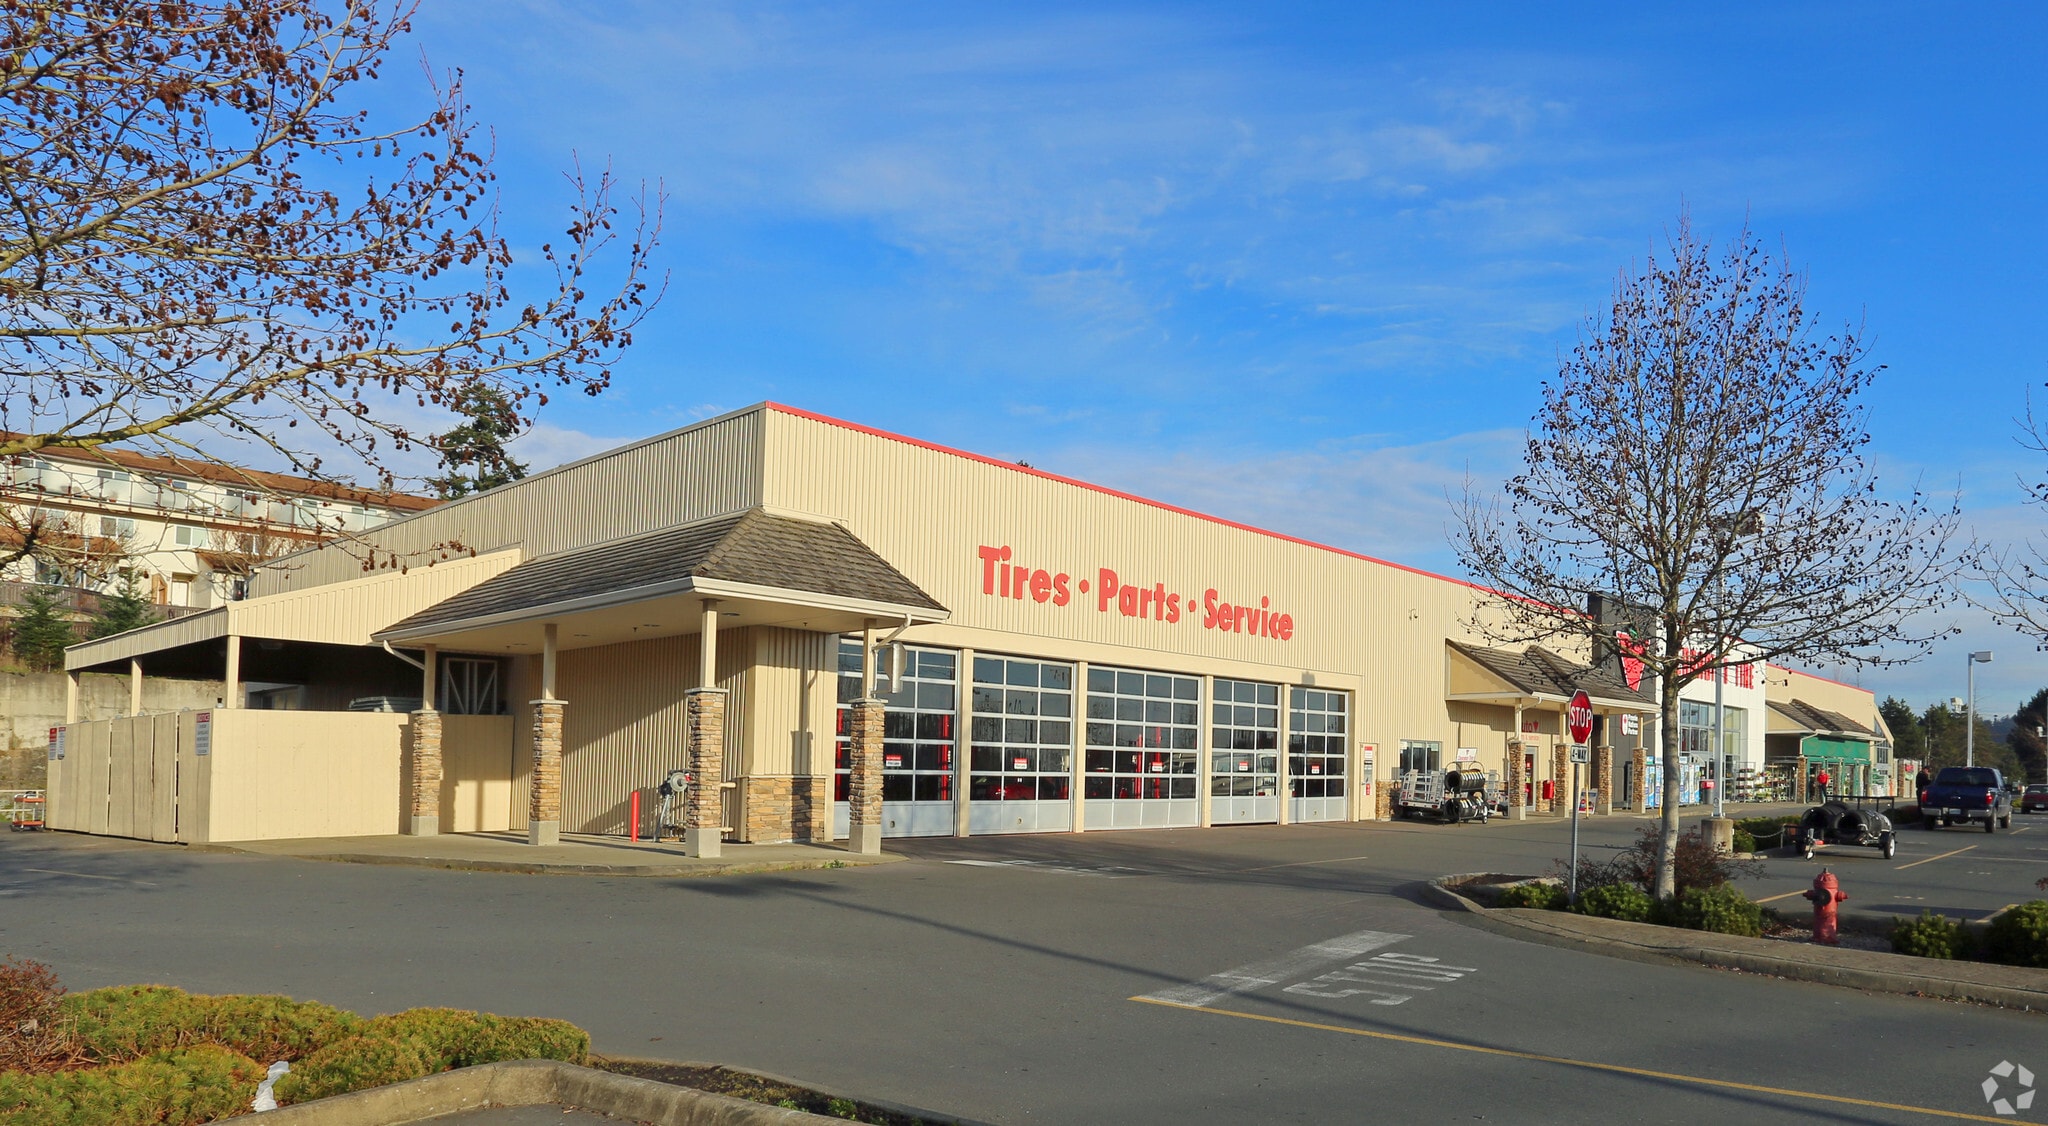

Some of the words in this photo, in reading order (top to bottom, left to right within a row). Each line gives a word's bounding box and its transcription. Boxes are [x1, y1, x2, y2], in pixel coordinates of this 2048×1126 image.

[978, 545, 1071, 607] Tires
[1098, 567, 1181, 624] Parts
[1203, 588, 1294, 641] Service
[1521, 720, 1533, 732] uto
[1570, 706, 1592, 728] STOP
[1282, 952, 1478, 1006] STOP
